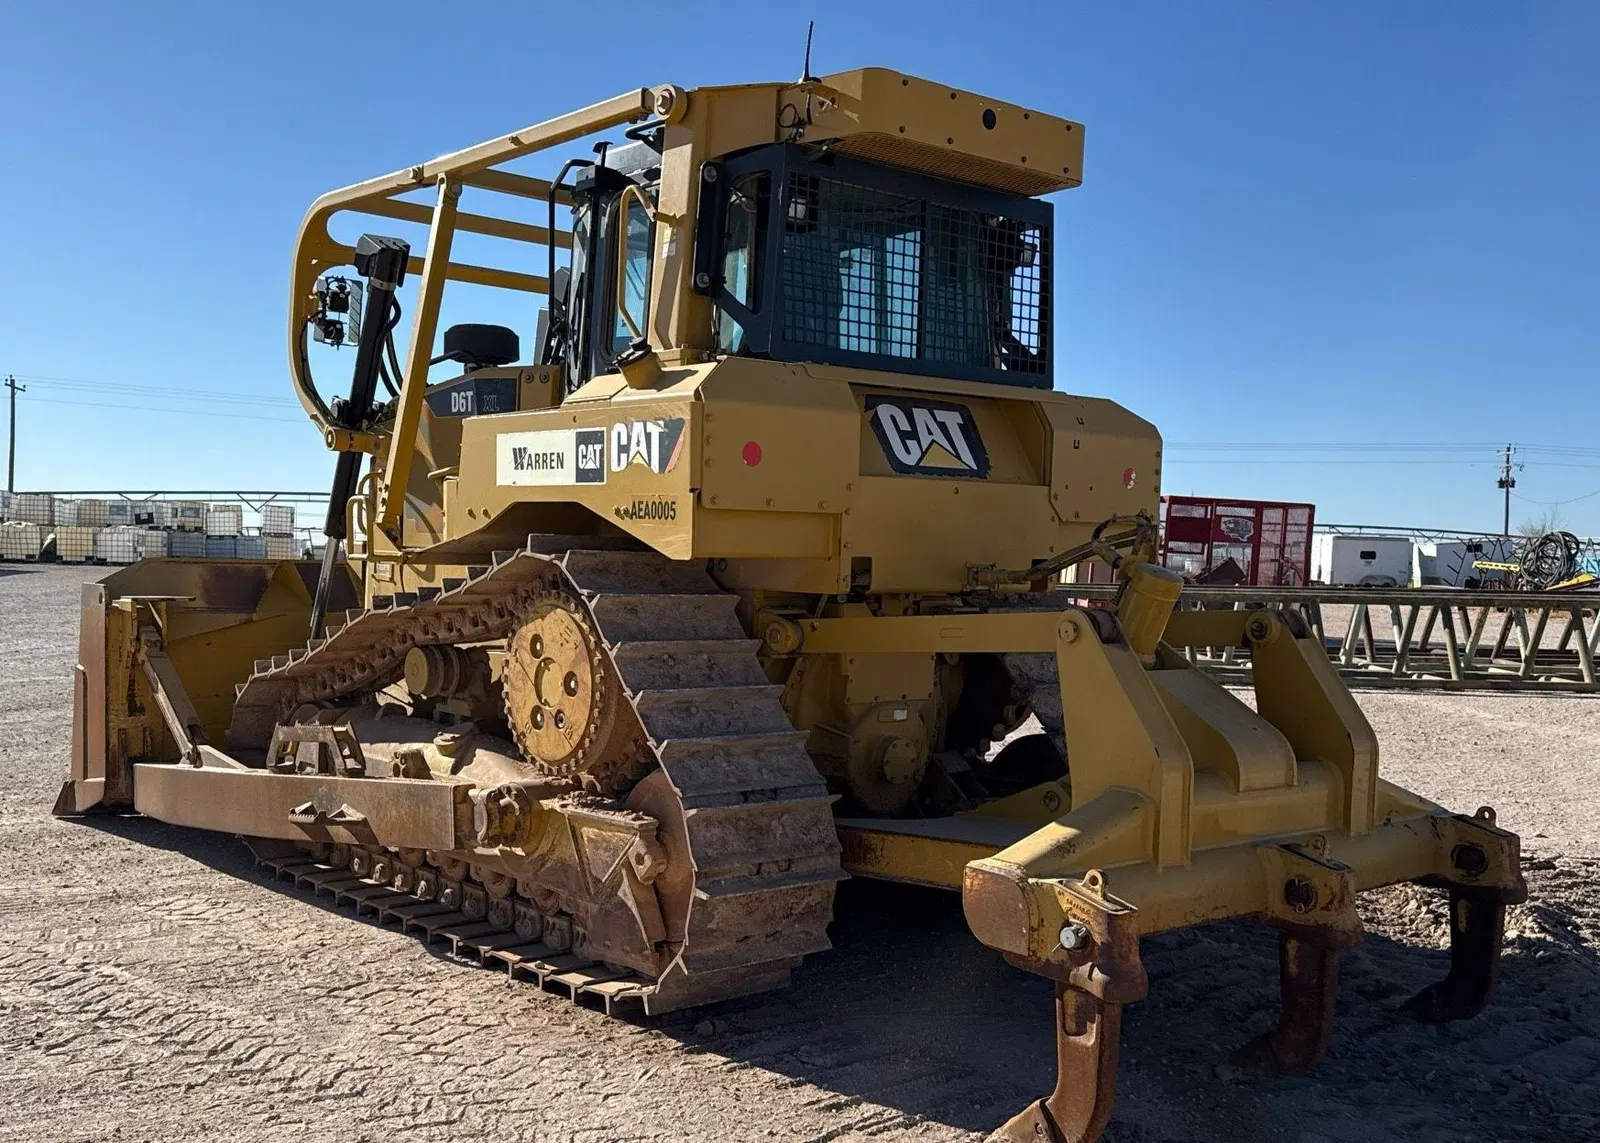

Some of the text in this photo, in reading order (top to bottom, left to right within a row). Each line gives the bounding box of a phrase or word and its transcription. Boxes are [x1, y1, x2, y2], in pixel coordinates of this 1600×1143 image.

[451, 390, 500, 413] D6T XL
[610, 420, 668, 475] CAT
[876, 403, 978, 470] CAT
[512, 443, 603, 471] WARREN CAT
[630, 500, 677, 521] AEA0005
